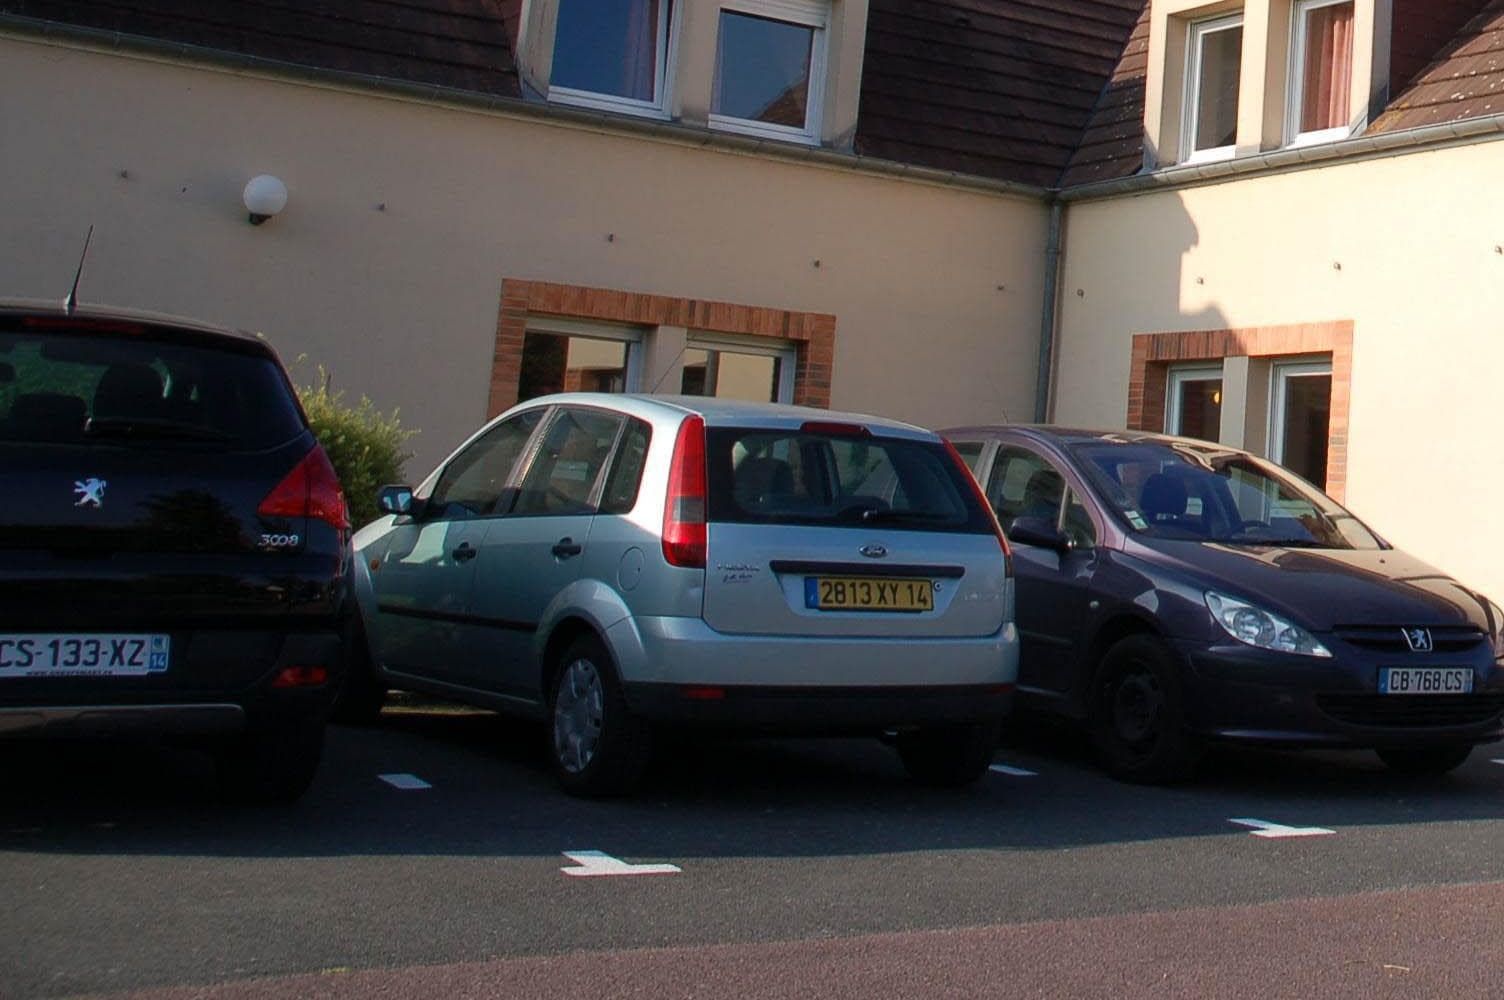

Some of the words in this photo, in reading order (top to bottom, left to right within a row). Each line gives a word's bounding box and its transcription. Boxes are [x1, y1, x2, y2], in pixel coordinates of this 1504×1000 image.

[257, 534, 299, 546] 3008
[820, 581, 872, 604] 2813
[876, 582, 899, 605] XY
[907, 584, 929, 606] 14
[0, 639, 146, 668] CS-133-XZ
[151, 654, 165, 667] 14
[1391, 671, 1462, 691] CB-768-CS
